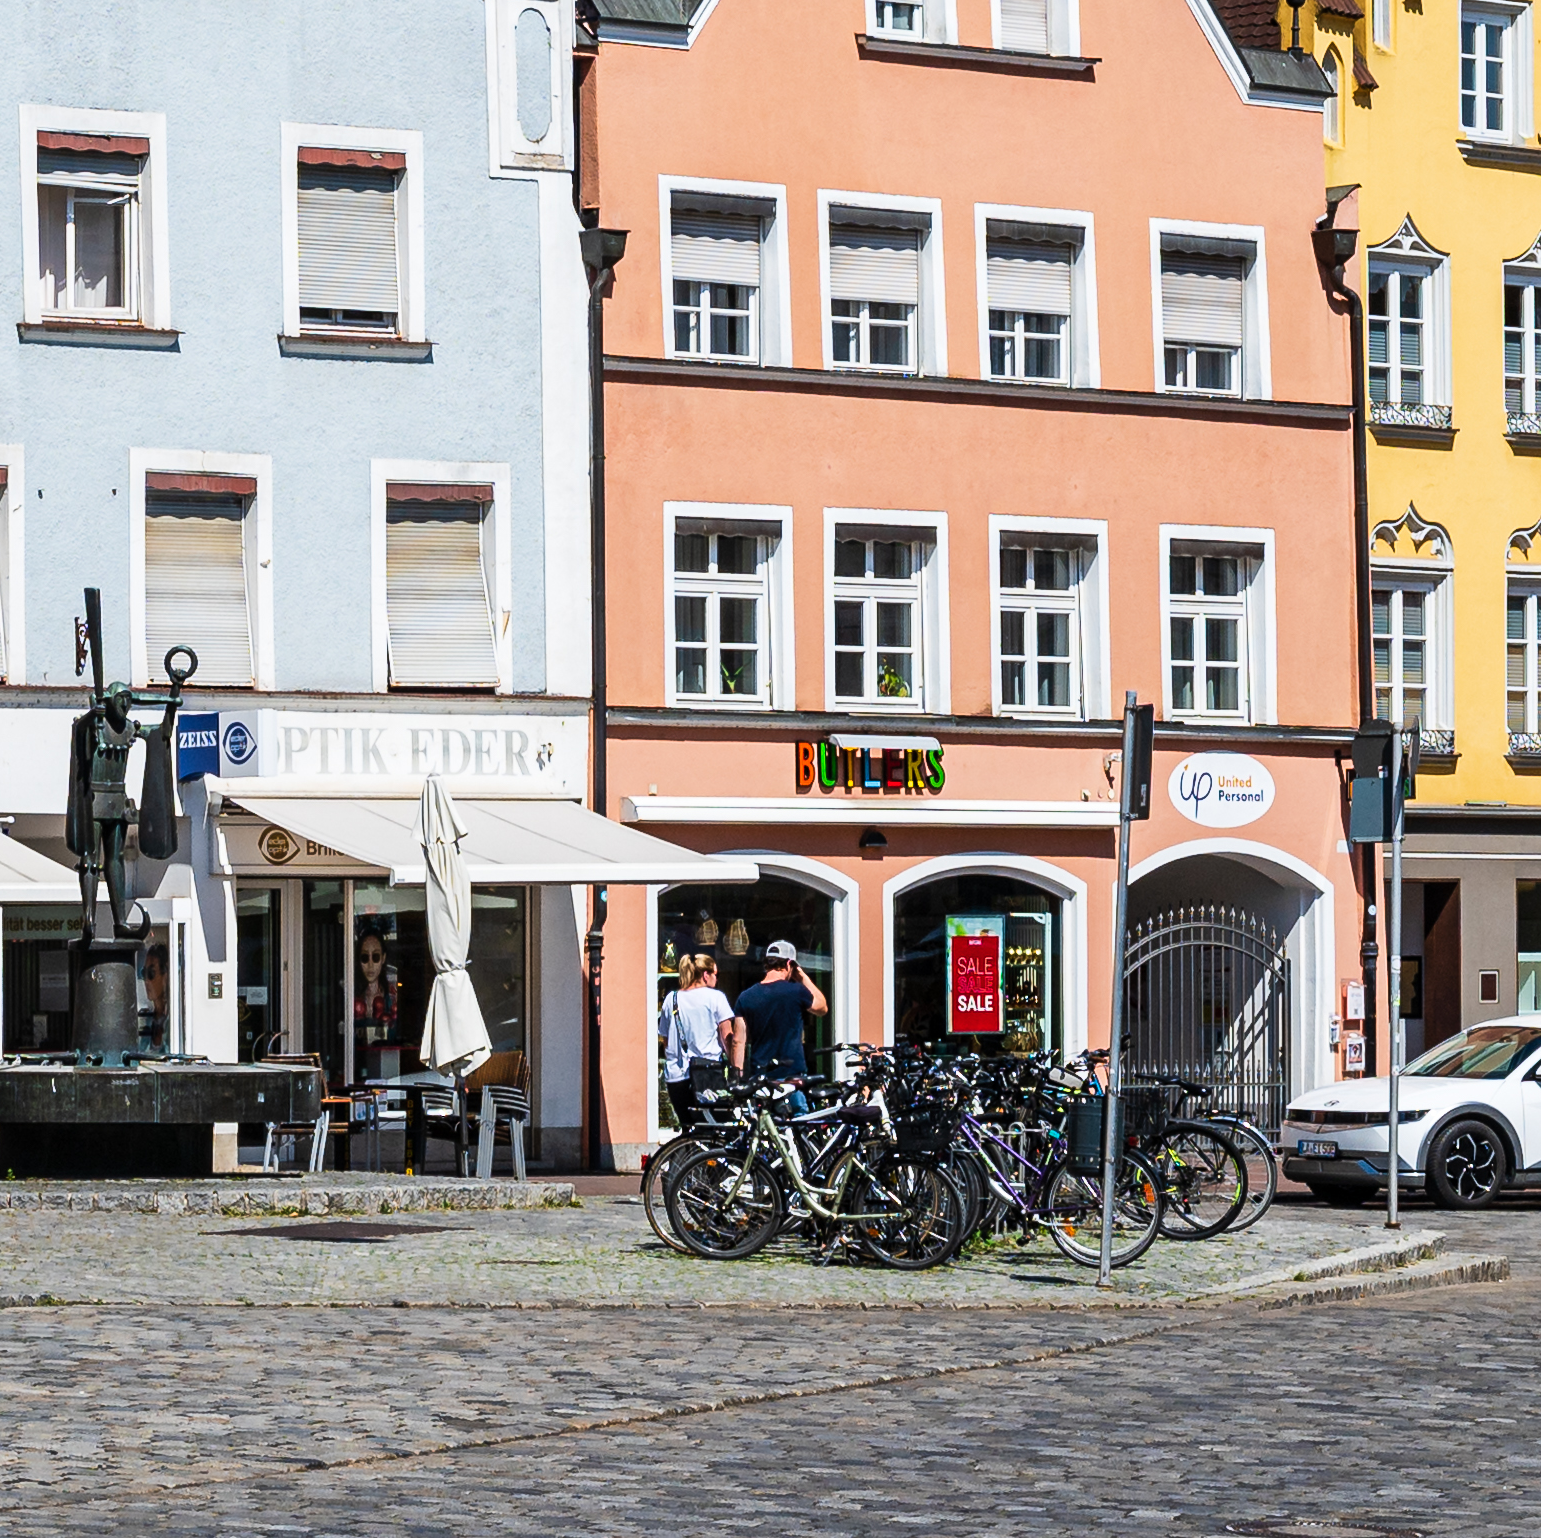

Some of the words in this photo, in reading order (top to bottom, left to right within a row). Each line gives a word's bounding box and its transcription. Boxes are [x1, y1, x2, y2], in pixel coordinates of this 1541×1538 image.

[179, 729, 217, 749] ZEISS
[274, 726, 391, 775] PTIK
[407, 727, 532, 776] EDER
[797, 741, 945, 789] BUTLERS
[1218, 775, 1252, 788] United
[1218, 789, 1264, 802] Personal
[26, 915, 64, 931] besser
[957, 956, 993, 975] SALE
[957, 975, 993, 993] SALE
[957, 994, 993, 1012] SALE
